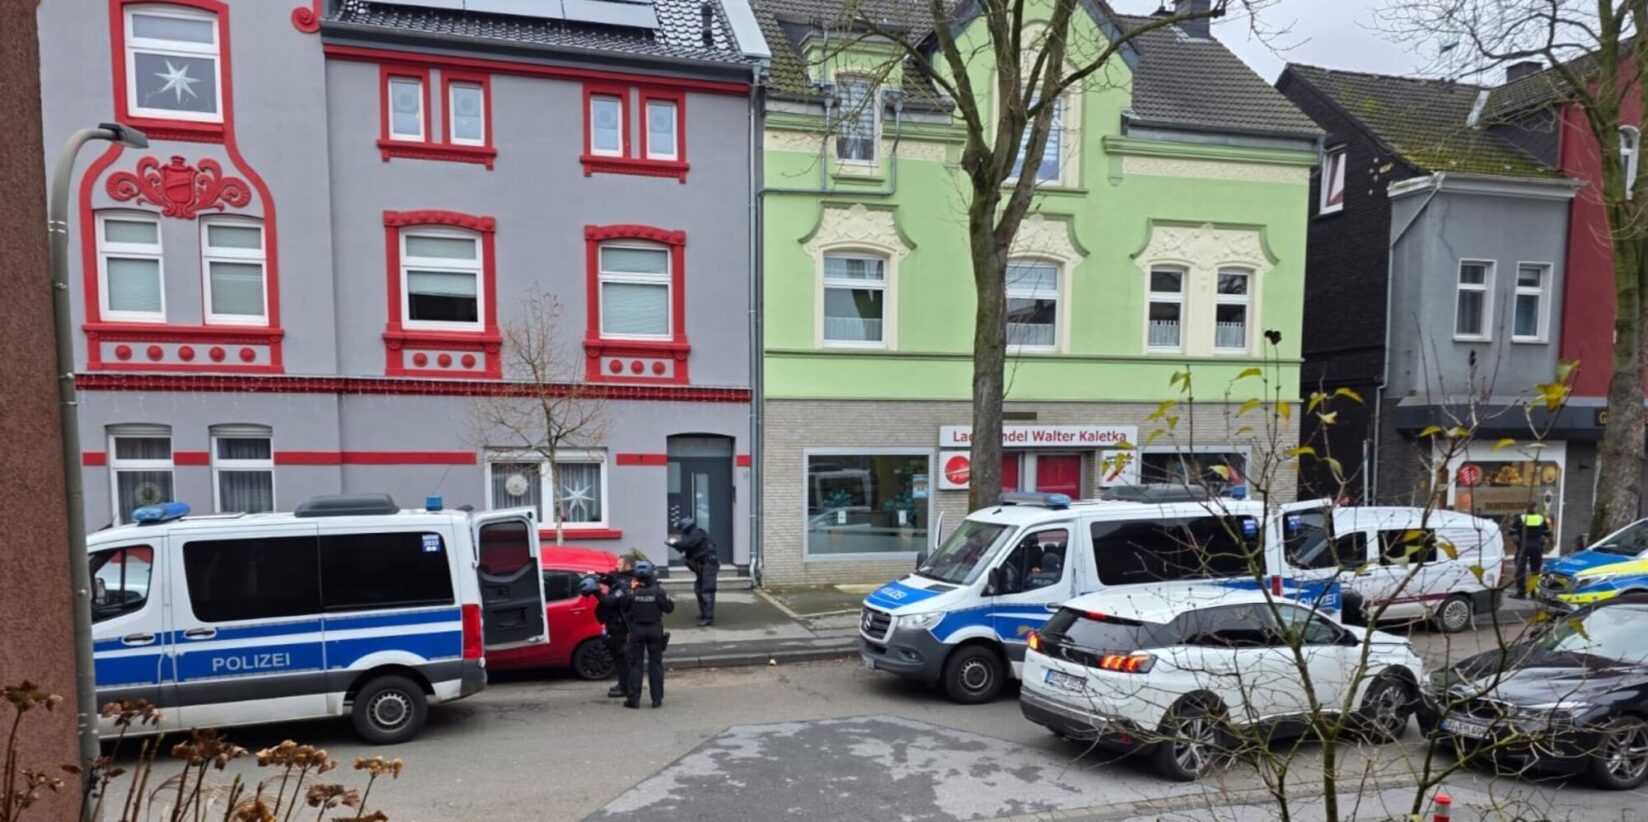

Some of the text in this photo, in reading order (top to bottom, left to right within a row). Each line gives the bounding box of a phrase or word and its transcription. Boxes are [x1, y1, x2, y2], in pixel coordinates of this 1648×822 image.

[1032, 430, 1076, 442] Walter
[1079, 430, 1127, 442] Kaletka
[212, 652, 290, 672] POLIZEI
